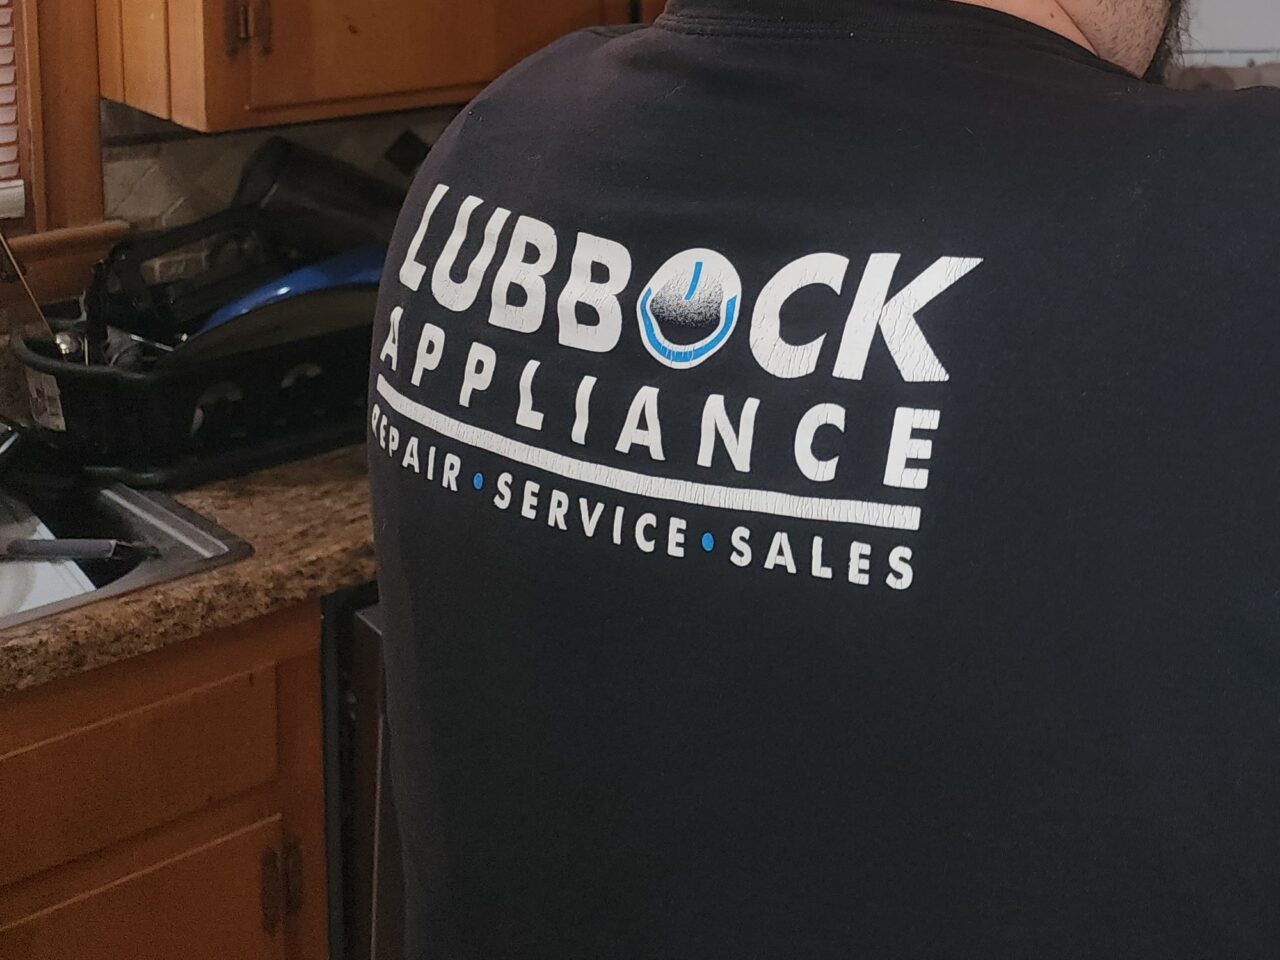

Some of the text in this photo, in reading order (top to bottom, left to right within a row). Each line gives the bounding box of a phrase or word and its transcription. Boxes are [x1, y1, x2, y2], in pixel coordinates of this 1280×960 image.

[398, 183, 984, 382] LUBBOCK
[380, 306, 941, 489] APPLIANCE
[371, 403, 914, 590] REPAIR SERVICE SALES
